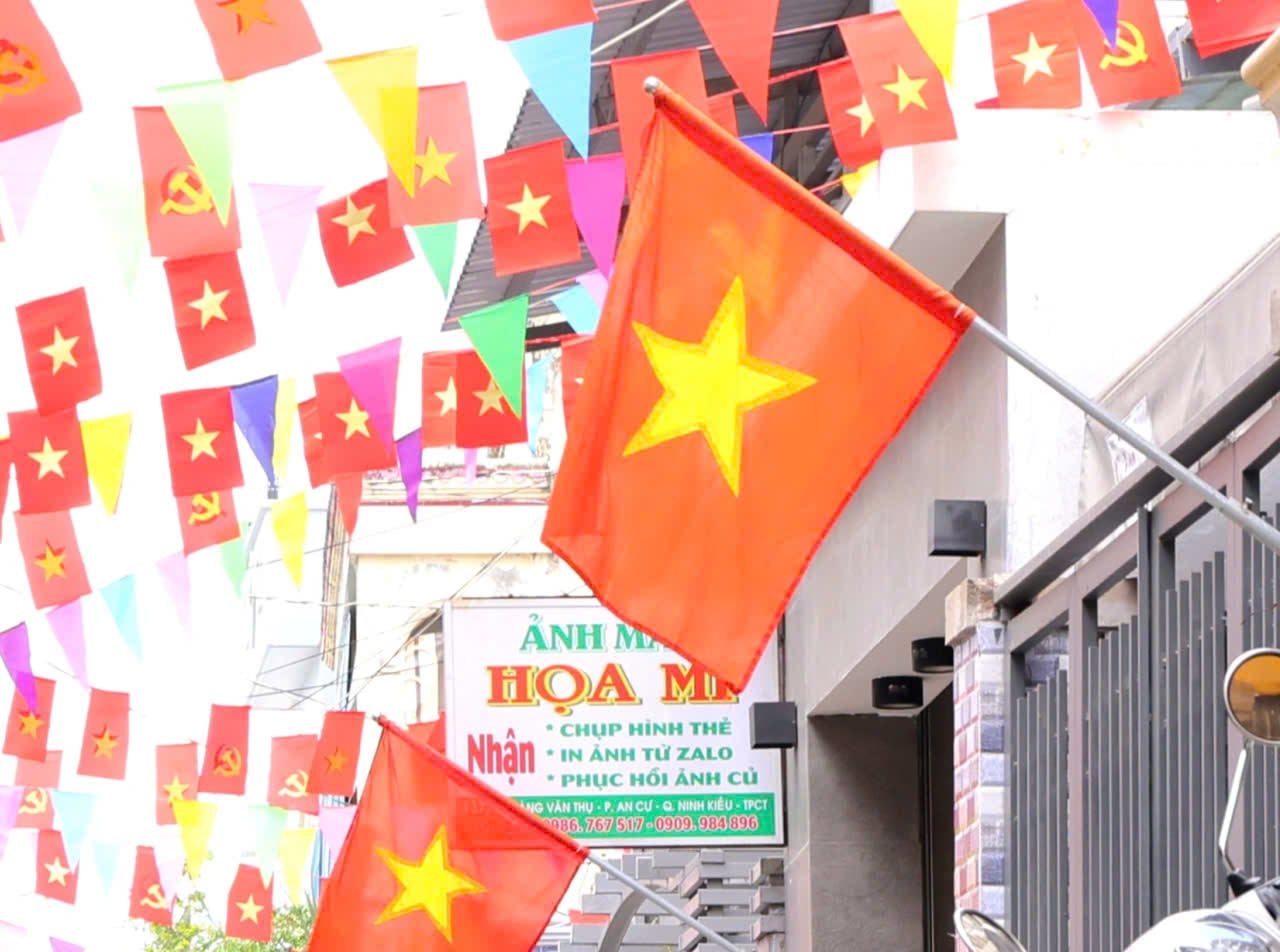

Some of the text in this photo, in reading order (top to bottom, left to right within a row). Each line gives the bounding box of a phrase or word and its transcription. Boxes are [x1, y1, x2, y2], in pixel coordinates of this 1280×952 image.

[520, 613, 604, 651] ẢNH
[486, 663, 639, 715] HỌA
[560, 722, 623, 741] CHỤP
[689, 716, 732, 736] THẺ
[467, 727, 535, 785] Nhận
[560, 748, 583, 762] IN
[589, 743, 636, 762] ẢNH
[677, 746, 734, 761] ZALO
[561, 772, 624, 791] PHỤC
[674, 767, 721, 786] ẢNH
[546, 799, 571, 814] VĂN
[617, 800, 634, 813] AN
[678, 799, 705, 812] NINH
[743, 799, 769, 811] TPCT
[586, 817, 613, 833] 767
[616, 816, 645, 832] 517
[655, 816, 697, 832] 0909.
[699, 815, 726, 832] 984
[729, 814, 758, 831] 896
